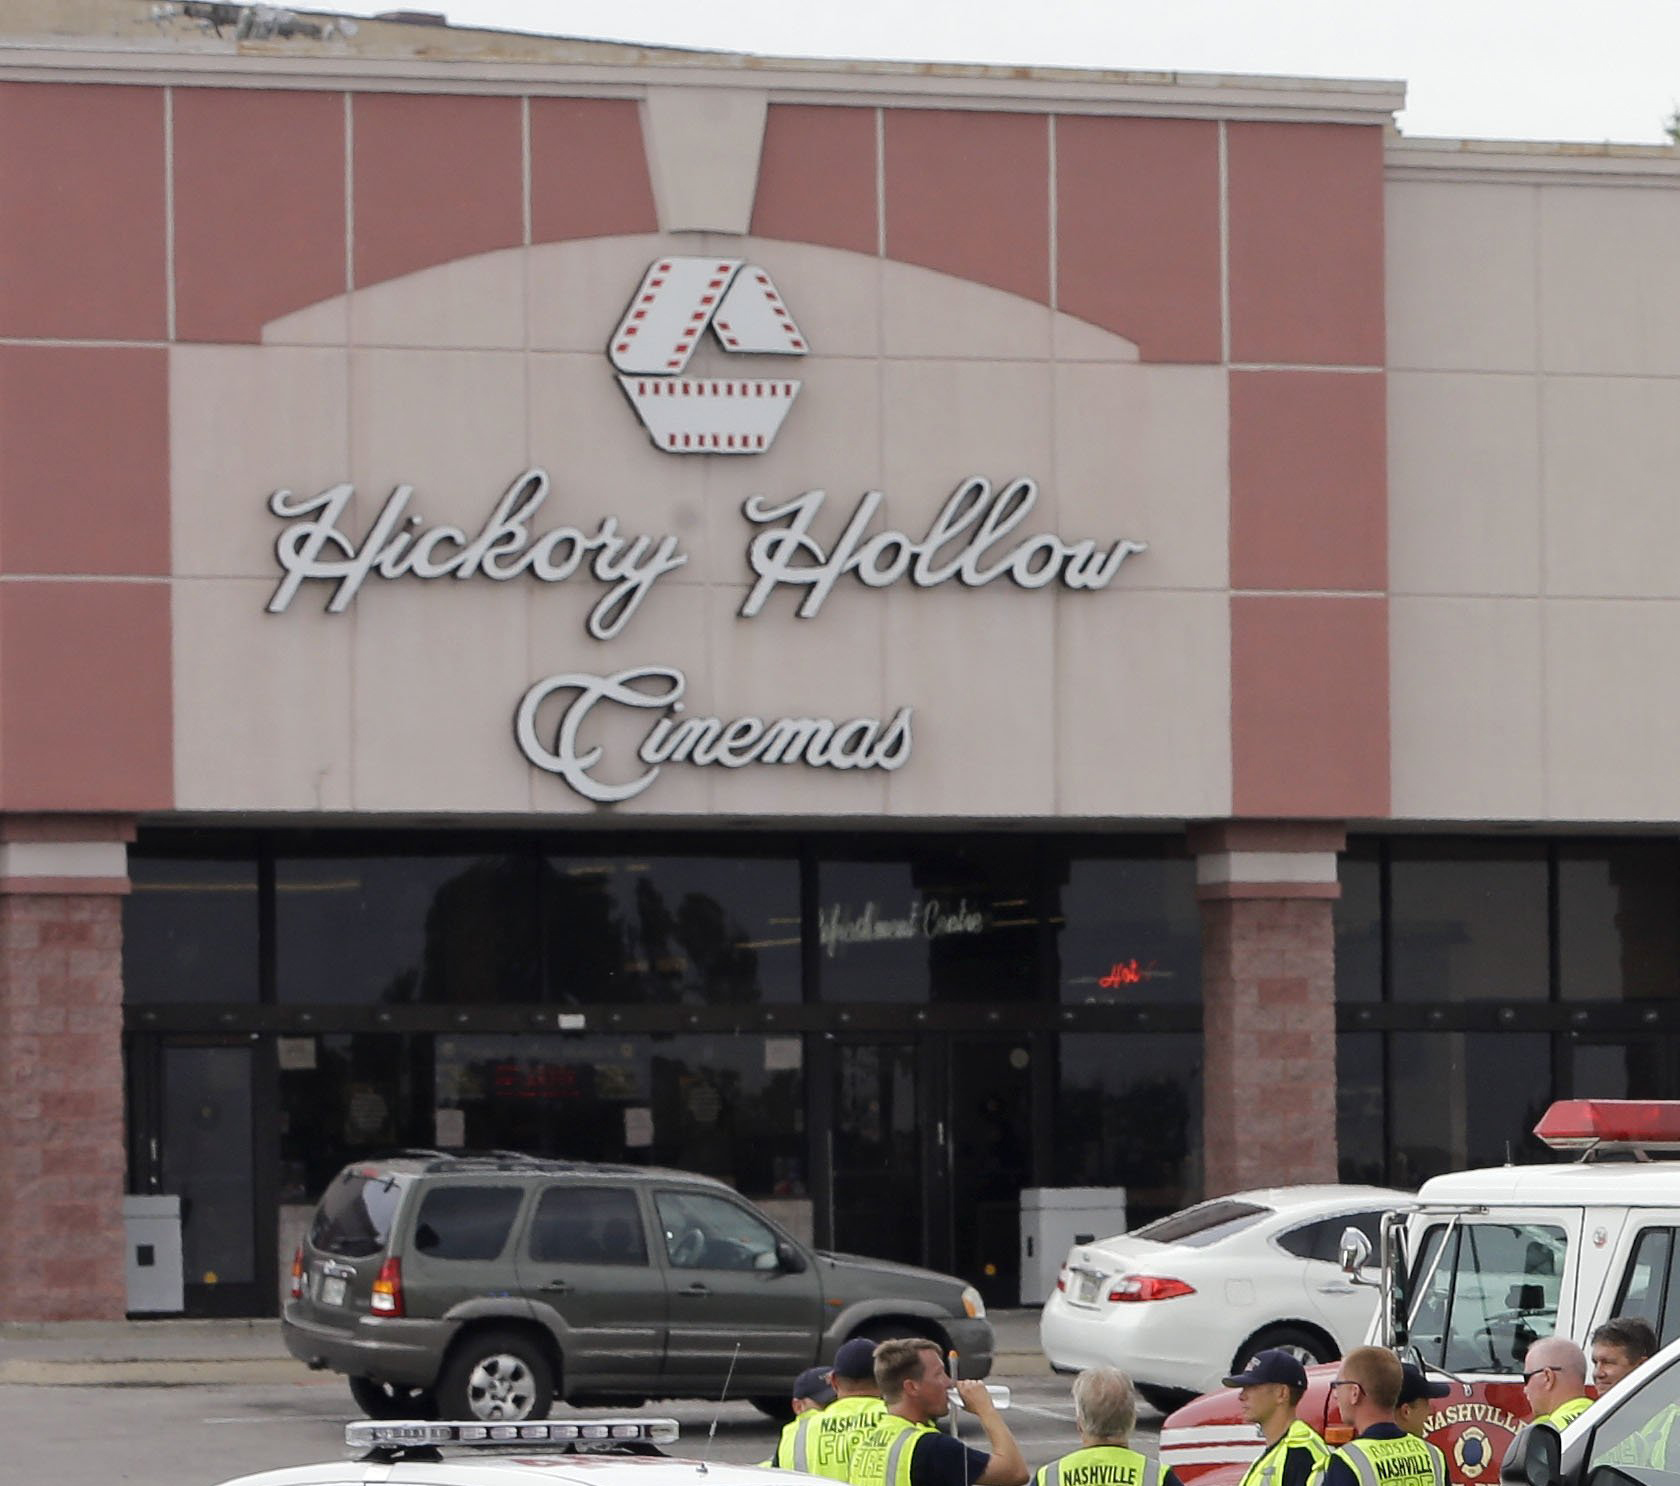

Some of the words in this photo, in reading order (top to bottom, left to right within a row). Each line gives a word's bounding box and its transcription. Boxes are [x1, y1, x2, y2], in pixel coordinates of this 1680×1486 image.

[268, 469, 689, 640] Hickory
[738, 477, 1147, 620] Hollow
[514, 666, 917, 803] Cinemas
[1064, 1465, 1137, 1486] NASHVILLE
[1375, 1455, 1432, 1480] NASHVILLE
